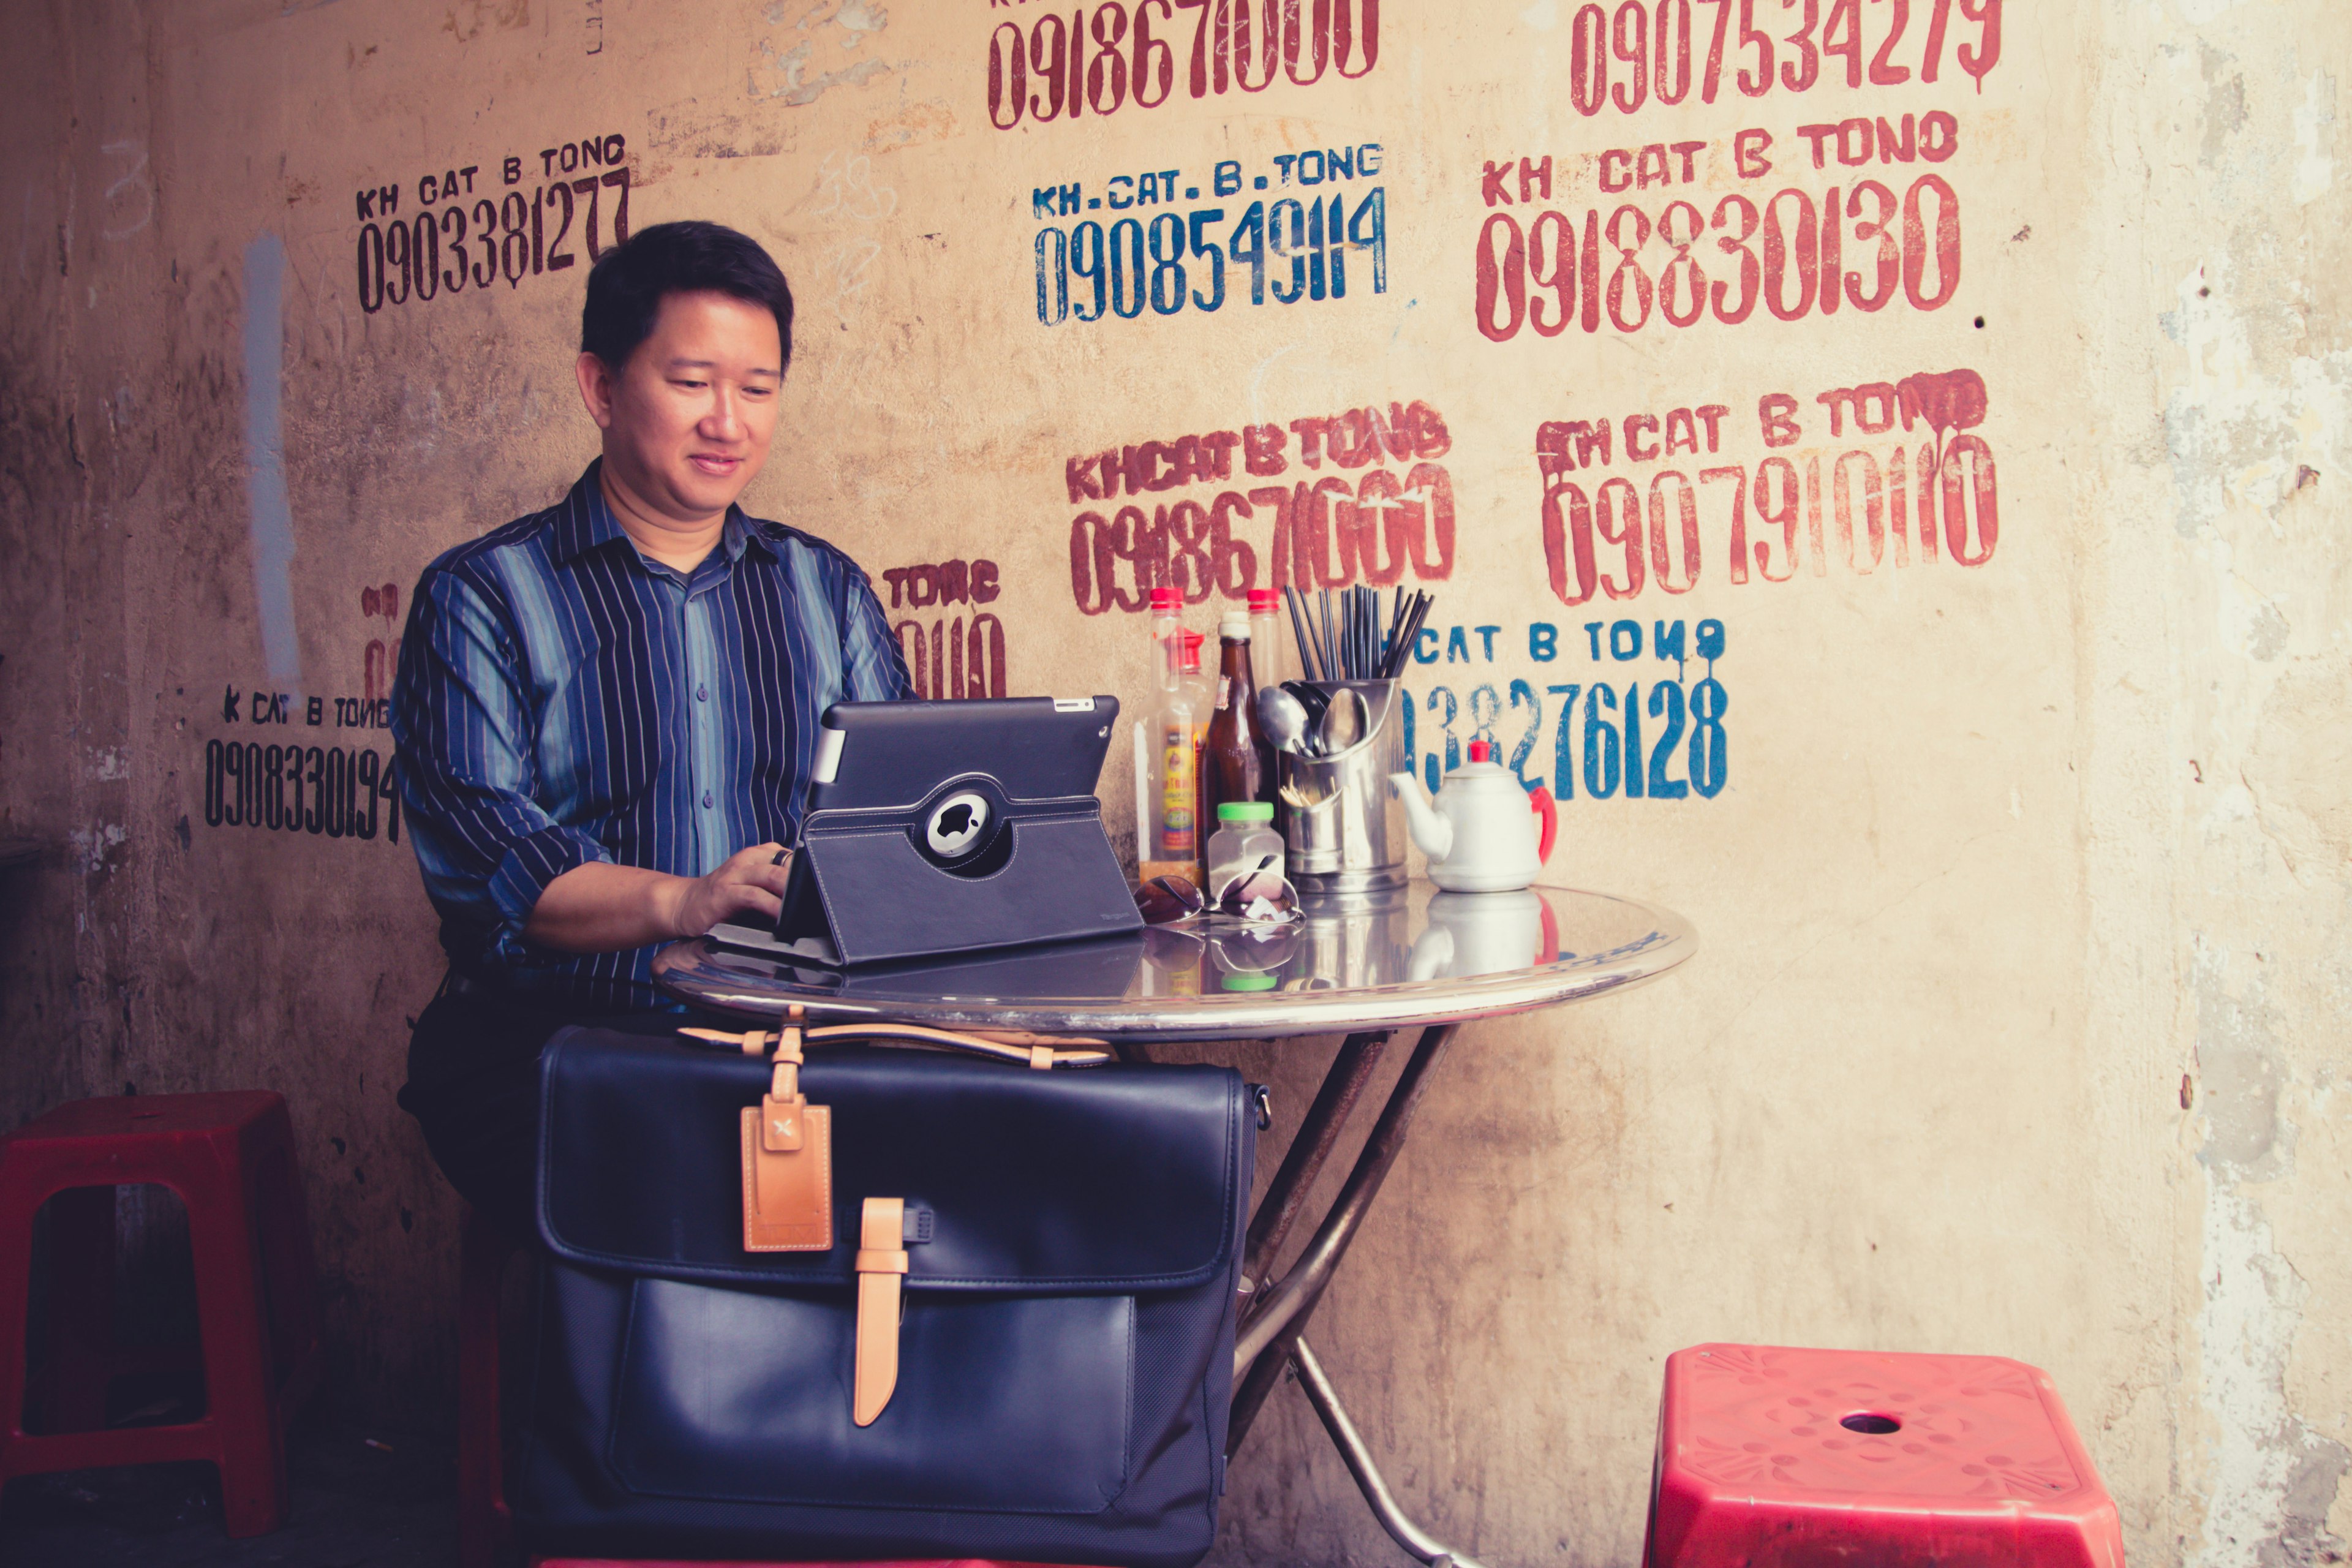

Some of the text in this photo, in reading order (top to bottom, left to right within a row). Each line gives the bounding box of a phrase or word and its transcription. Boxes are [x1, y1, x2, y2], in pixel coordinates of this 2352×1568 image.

[987, 0, 1381, 130] 0918671000
[356, 184, 398, 221] KH
[418, 166, 479, 205] CAT
[503, 157, 521, 185] B
[1481, 156, 1553, 206] KH
[1599, 140, 1707, 193] CAT
[1735, 127, 1773, 178] B
[357, 167, 631, 314] 0903381277
[1035, 187, 1387, 326] 0908549114
[1475, 173, 1961, 343] 0918830130
[1623, 404, 1730, 462] CAT
[1757, 393, 1802, 448] B
[1069, 463, 1456, 616] 0918671000
[1542, 434, 1998, 606] 0907910110
[1414, 625, 1501, 665] CAT
[1529, 621, 1558, 662] B
[224, 684, 240, 723] K
[253, 692, 290, 725] CAT
[307, 696, 322, 726] B
[205, 739, 400, 845] 0908330194
